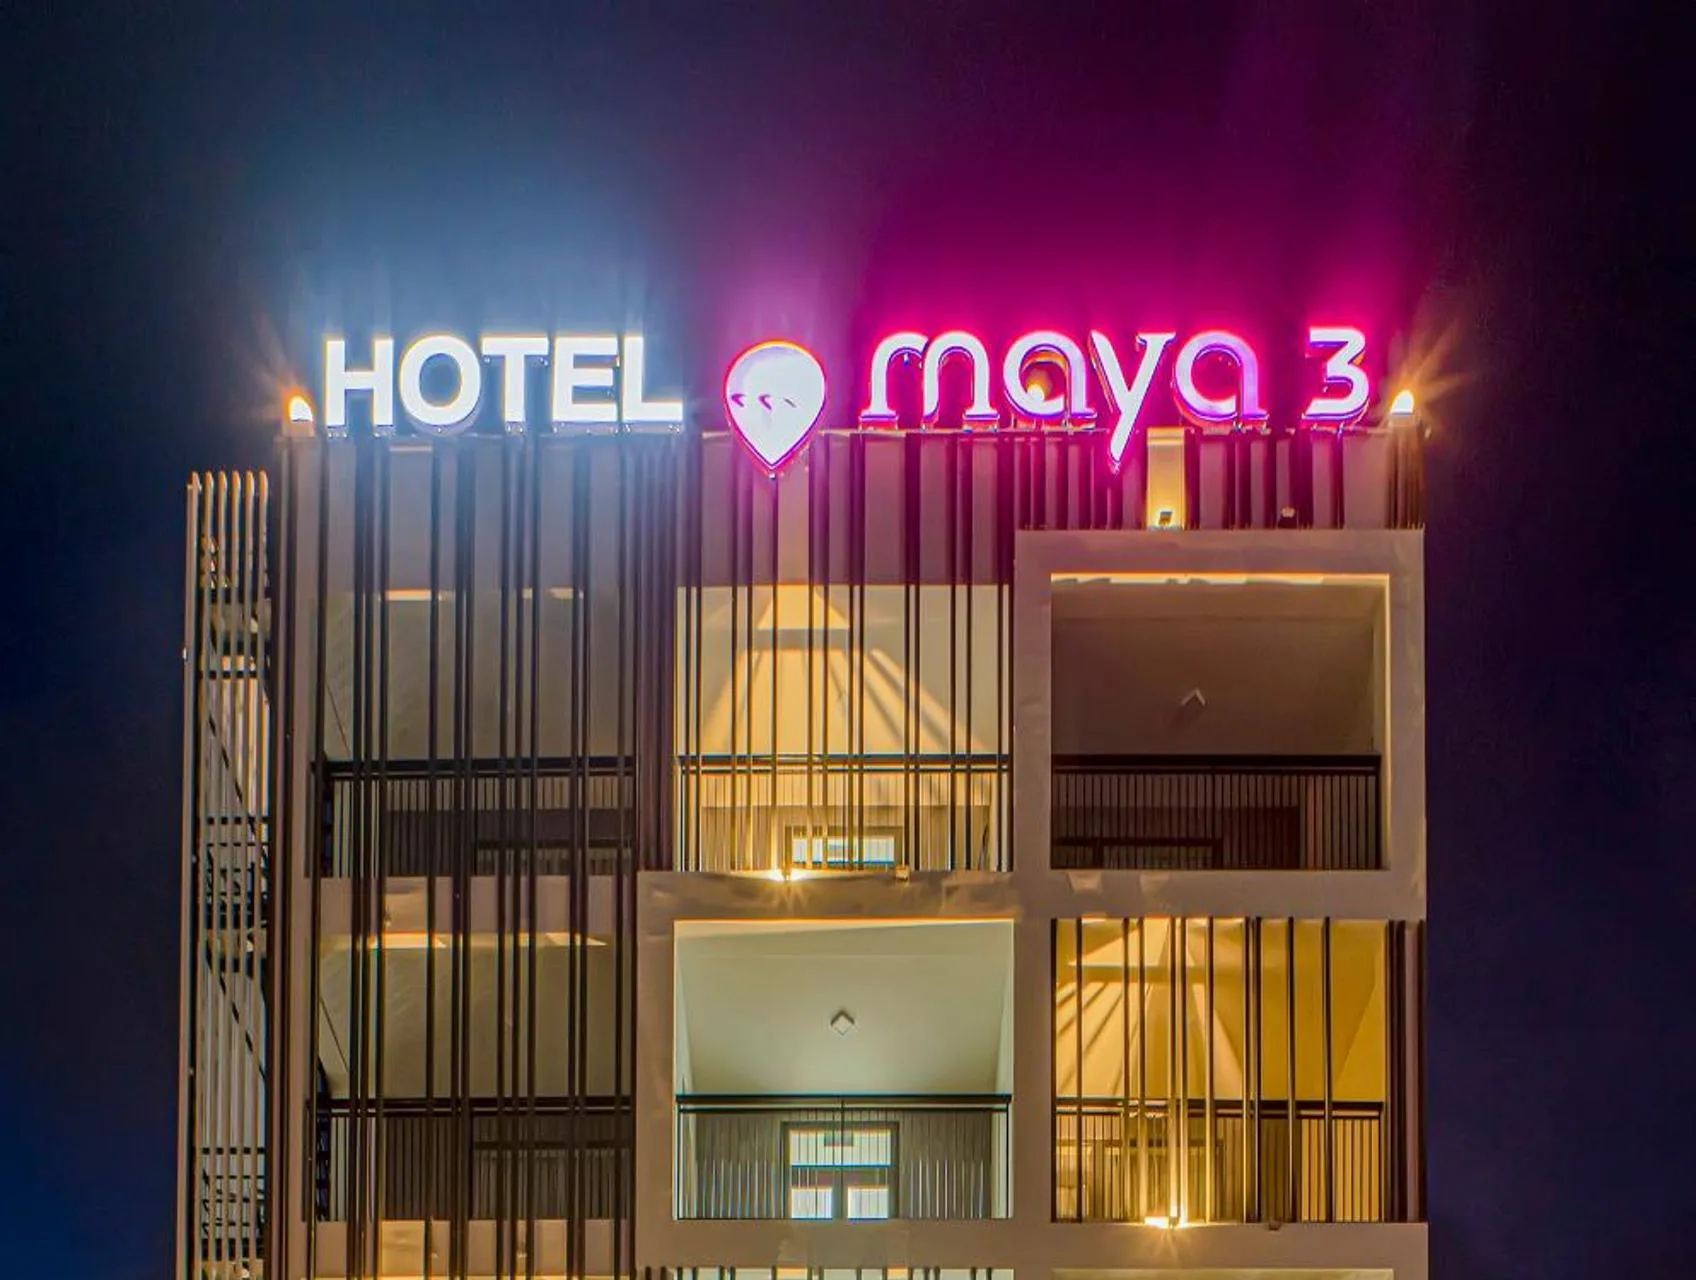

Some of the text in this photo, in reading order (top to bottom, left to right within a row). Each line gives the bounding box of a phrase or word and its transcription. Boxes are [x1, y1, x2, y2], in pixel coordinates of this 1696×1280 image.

[324, 327, 1370, 465] HOTEL maya 3
